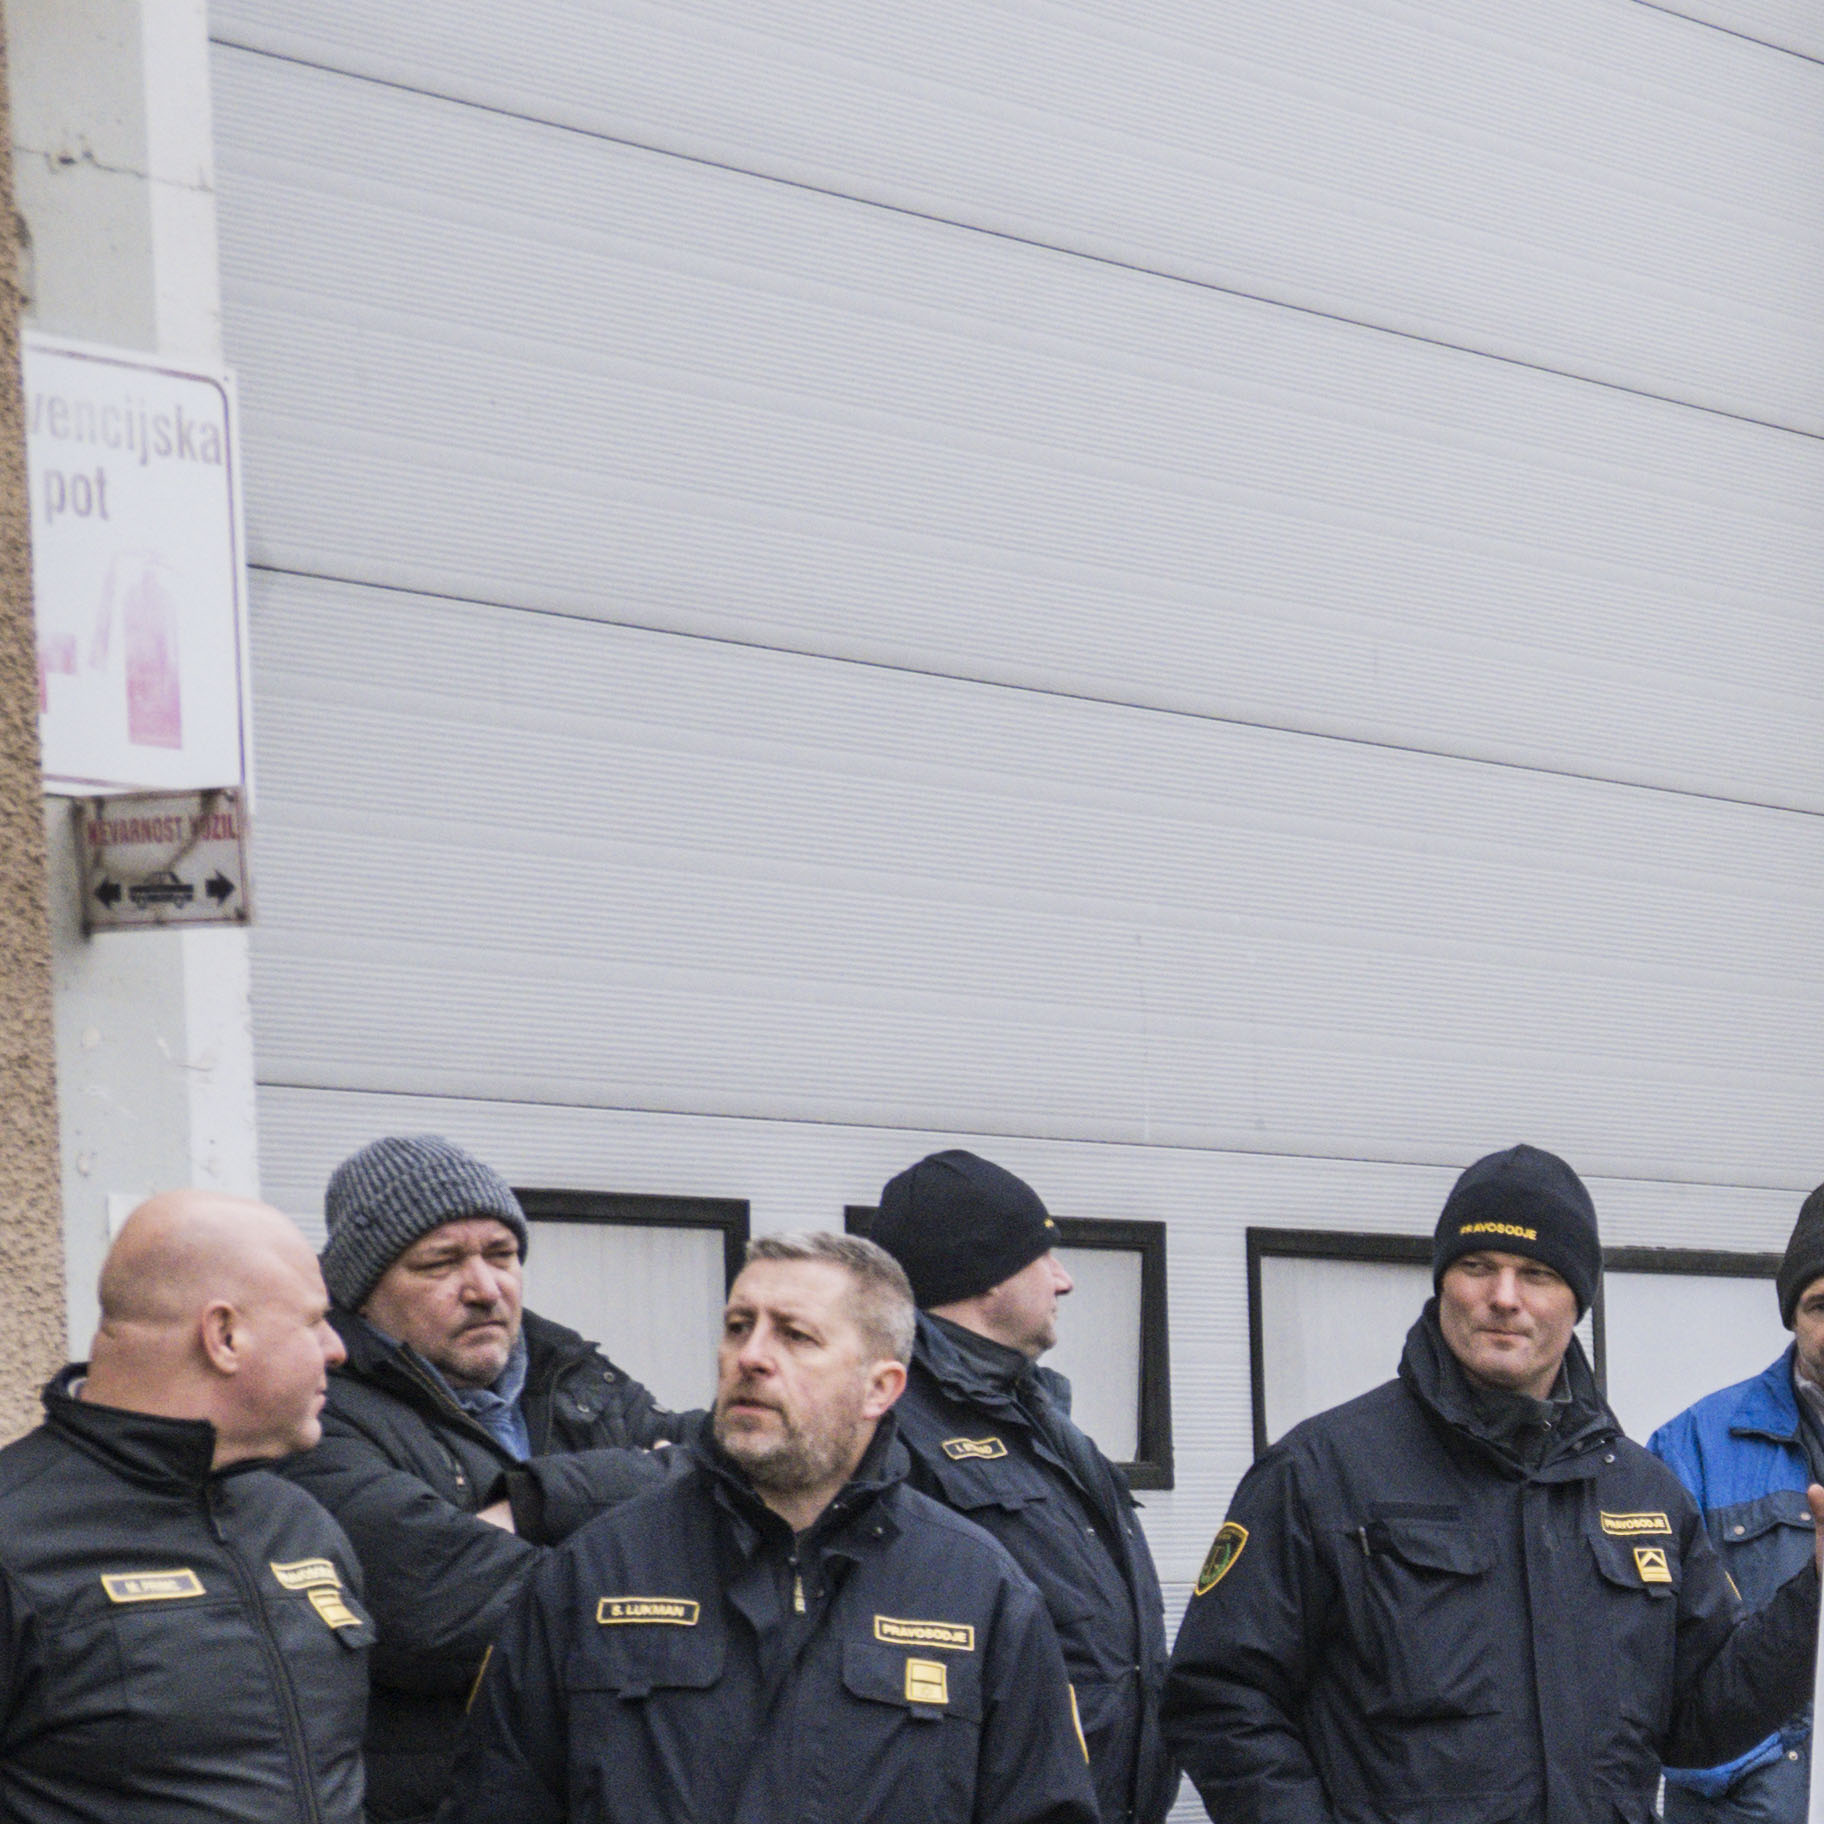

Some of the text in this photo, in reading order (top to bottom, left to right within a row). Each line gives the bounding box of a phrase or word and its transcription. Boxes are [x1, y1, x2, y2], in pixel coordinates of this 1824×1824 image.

[44, 466, 110, 525] pot
[625, 1604, 685, 1618] LUKMAN
[881, 1623, 968, 1643] PRAVOSODJE
